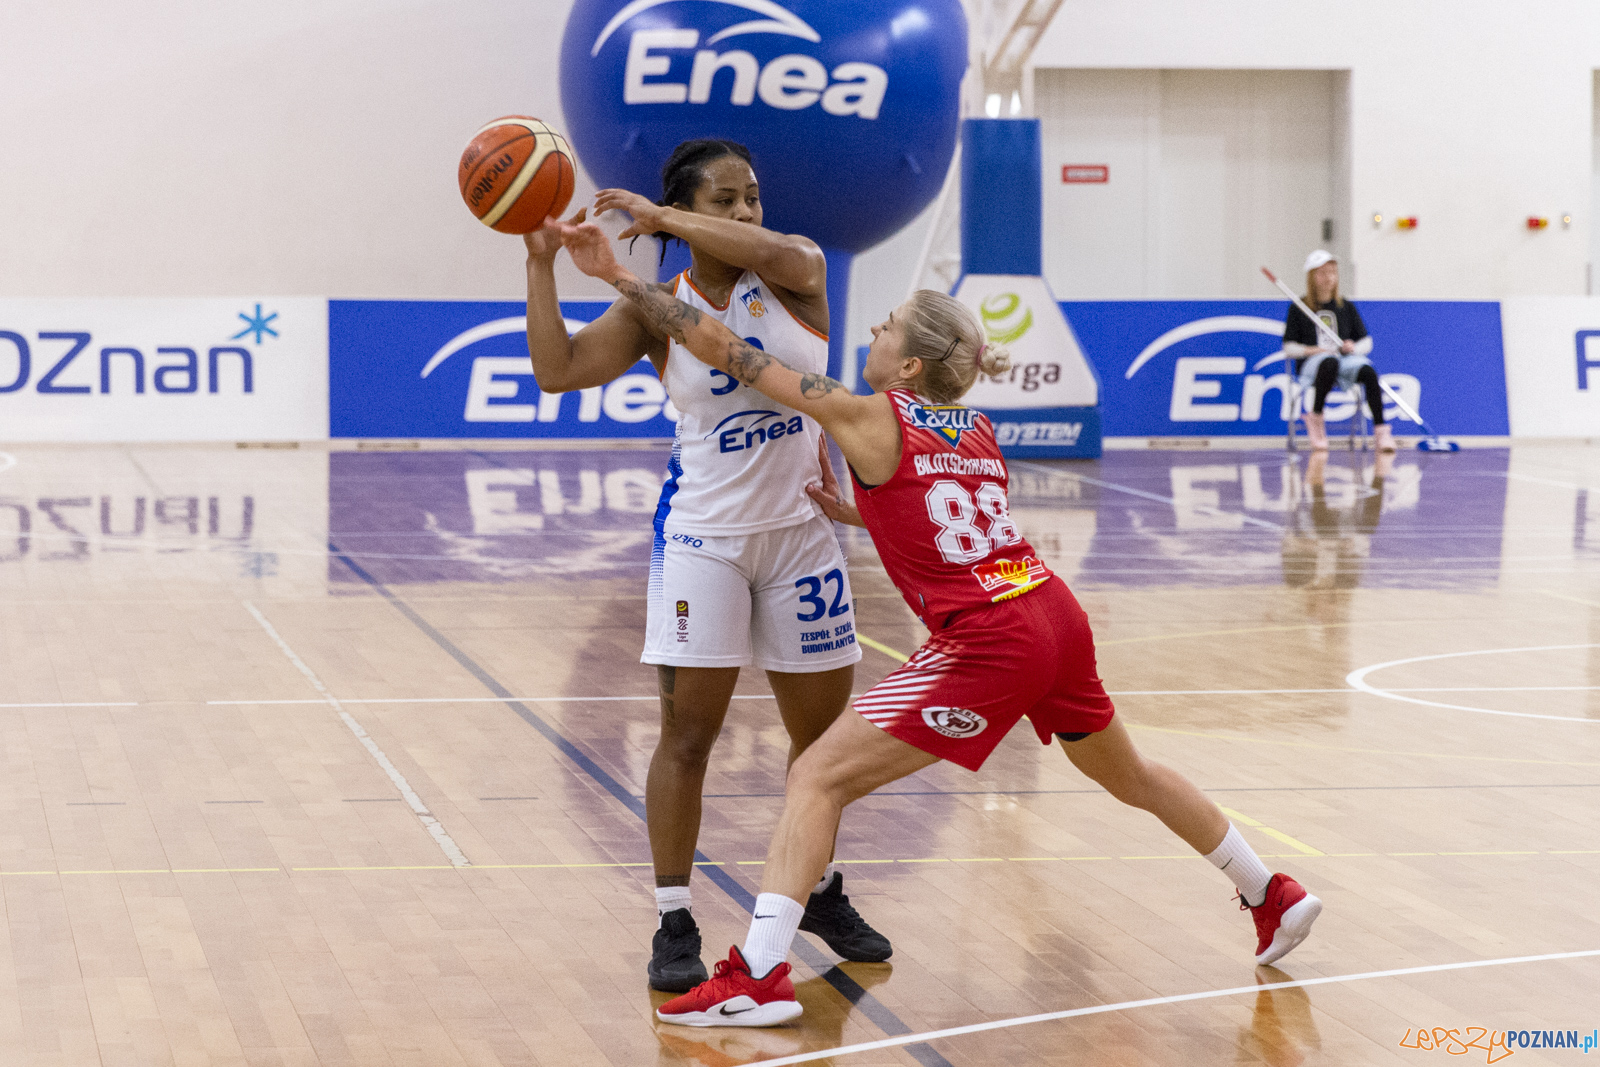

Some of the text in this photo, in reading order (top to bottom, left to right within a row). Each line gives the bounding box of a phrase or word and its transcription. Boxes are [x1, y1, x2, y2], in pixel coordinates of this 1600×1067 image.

[623, 28, 889, 120] Enea
[469, 153, 514, 208] molten
[463, 356, 678, 424] Ene
[719, 415, 804, 454] Enea
[924, 479, 1023, 566] 88
[794, 567, 850, 623] 32
[799, 628, 832, 642] ZESPÓŁ
[801, 632, 856, 655] BUDOWLANYCH
